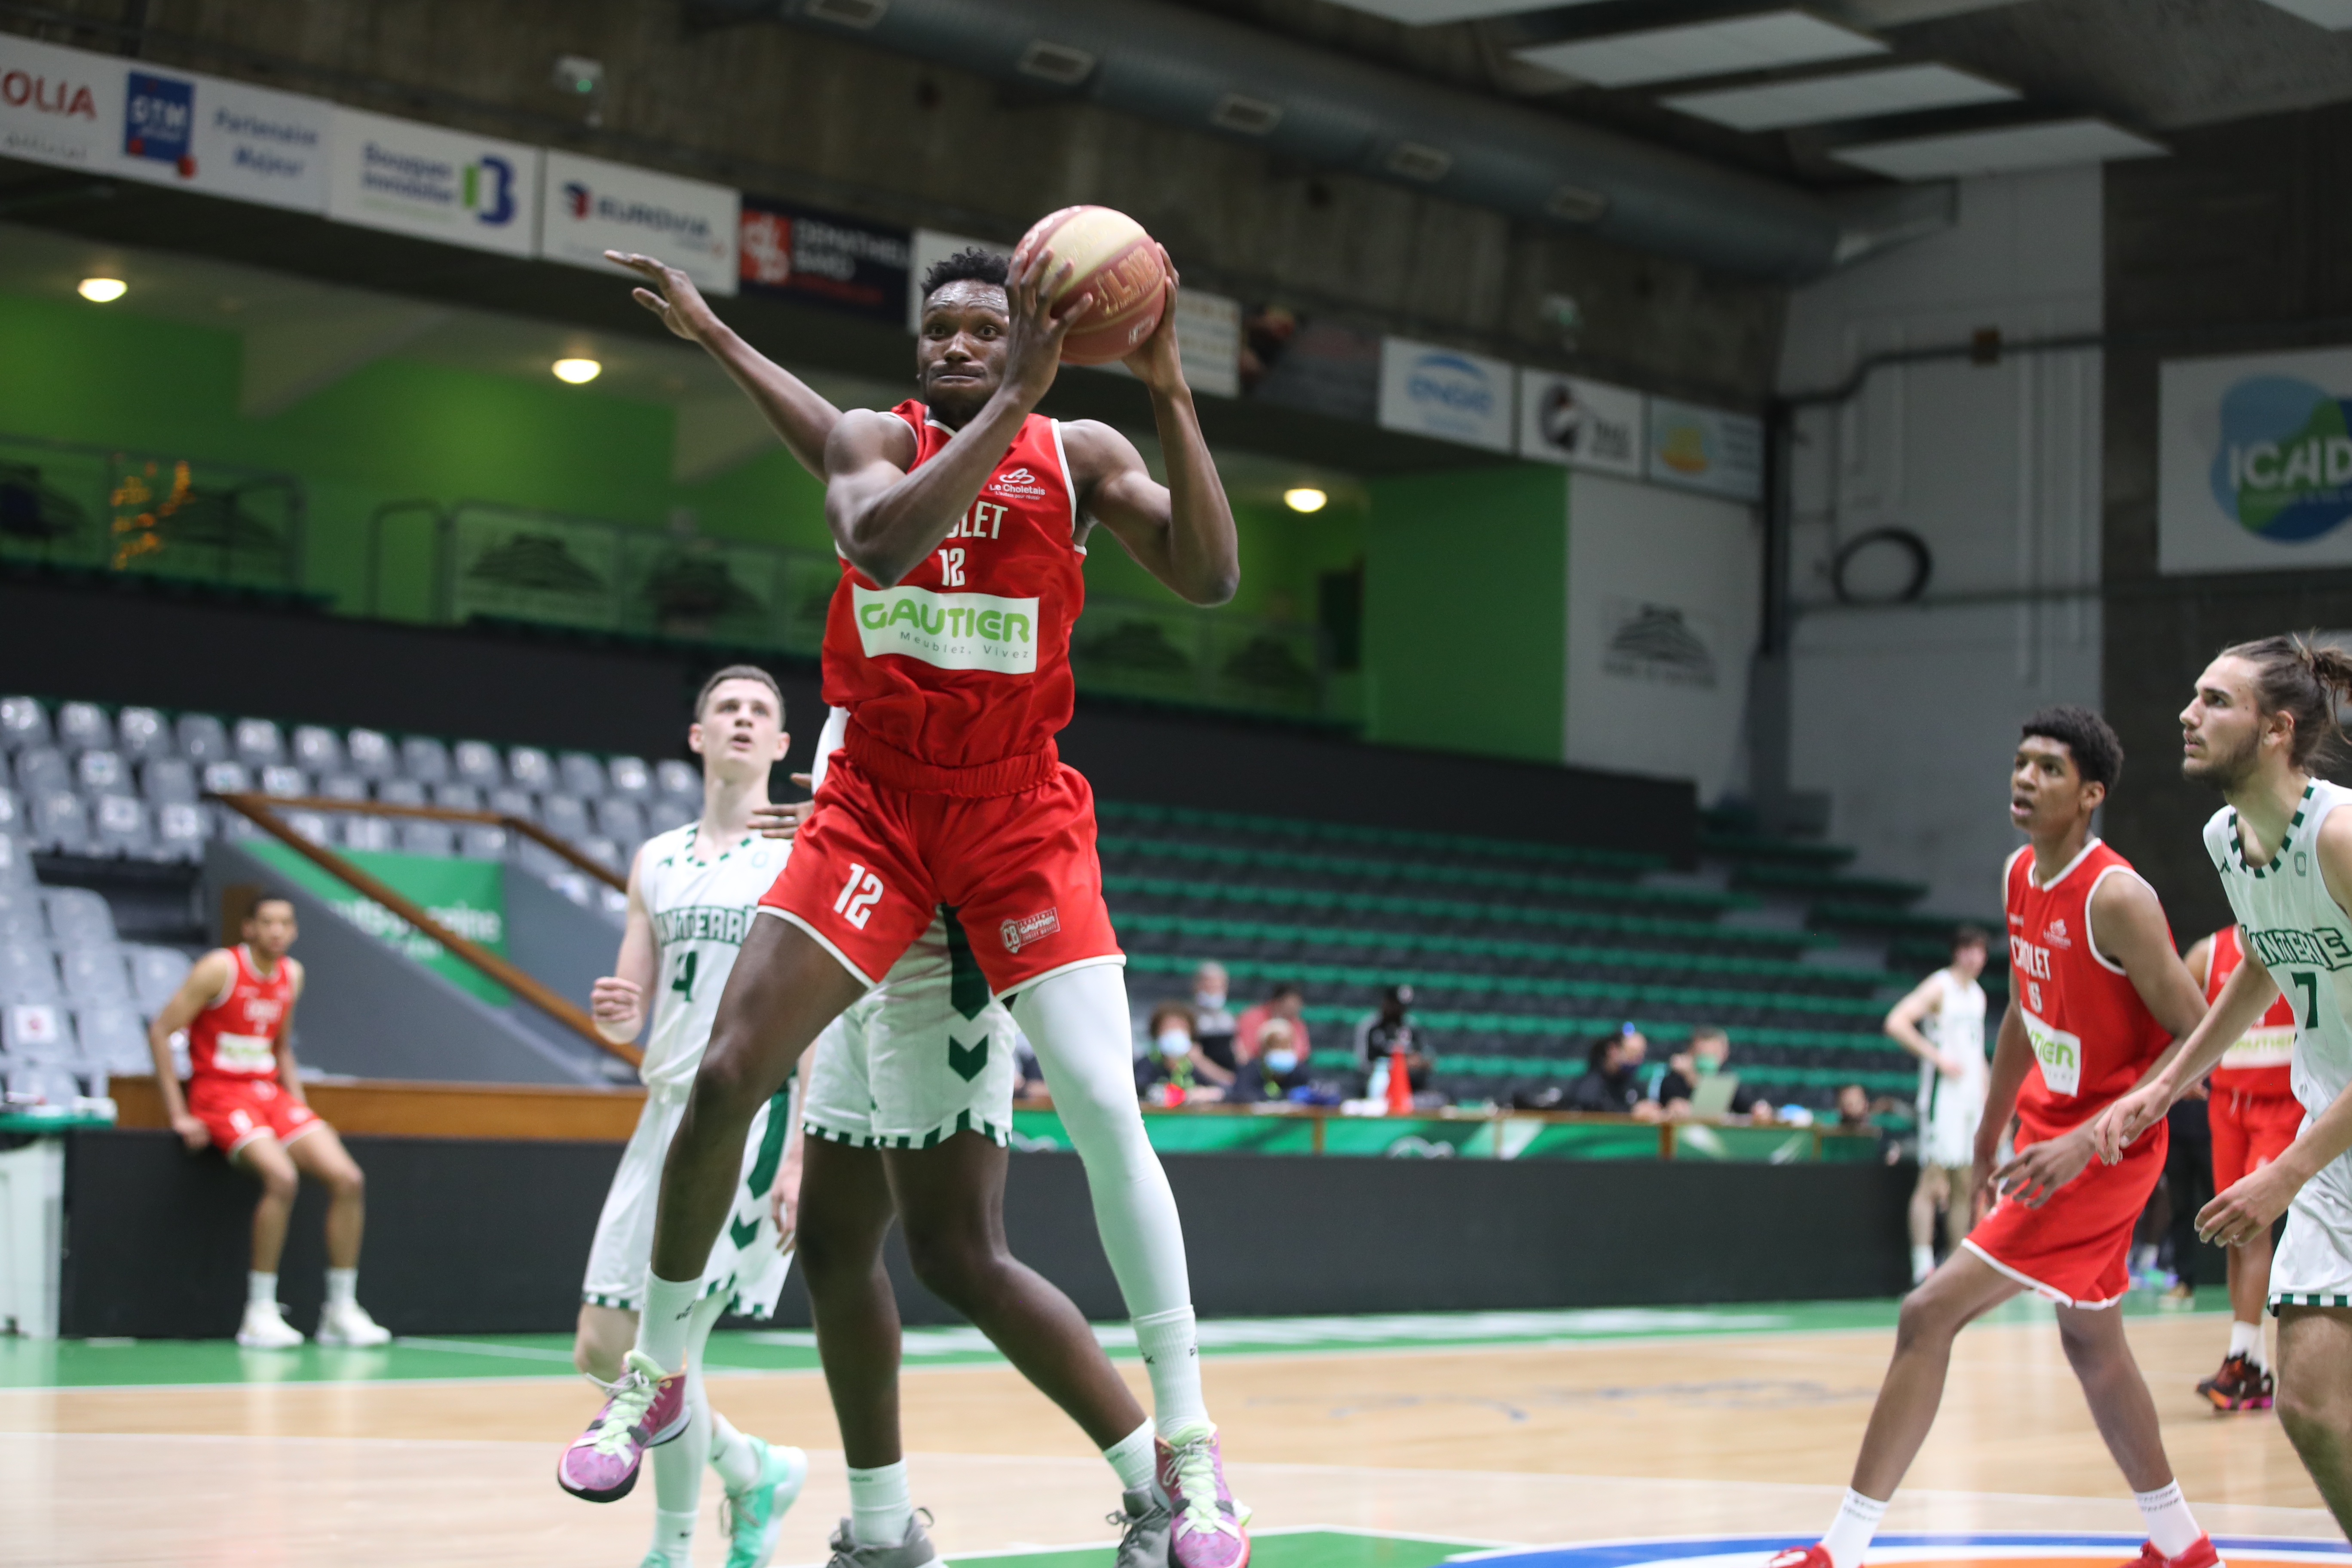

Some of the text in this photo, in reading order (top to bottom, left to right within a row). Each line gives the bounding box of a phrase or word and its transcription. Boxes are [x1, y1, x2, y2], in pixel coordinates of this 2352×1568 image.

[0, 69, 98, 121] OLIA
[1003, 484, 1046, 496] Choletais
[938, 548, 965, 587] 12
[861, 598, 1030, 643] GAUTIER
[900, 631, 1029, 658] Meublez, Vivez
[833, 862, 884, 930] 12
[1003, 925, 1020, 947] CB
[671, 950, 698, 1002] 4
[2291, 972, 2318, 1029] 7
